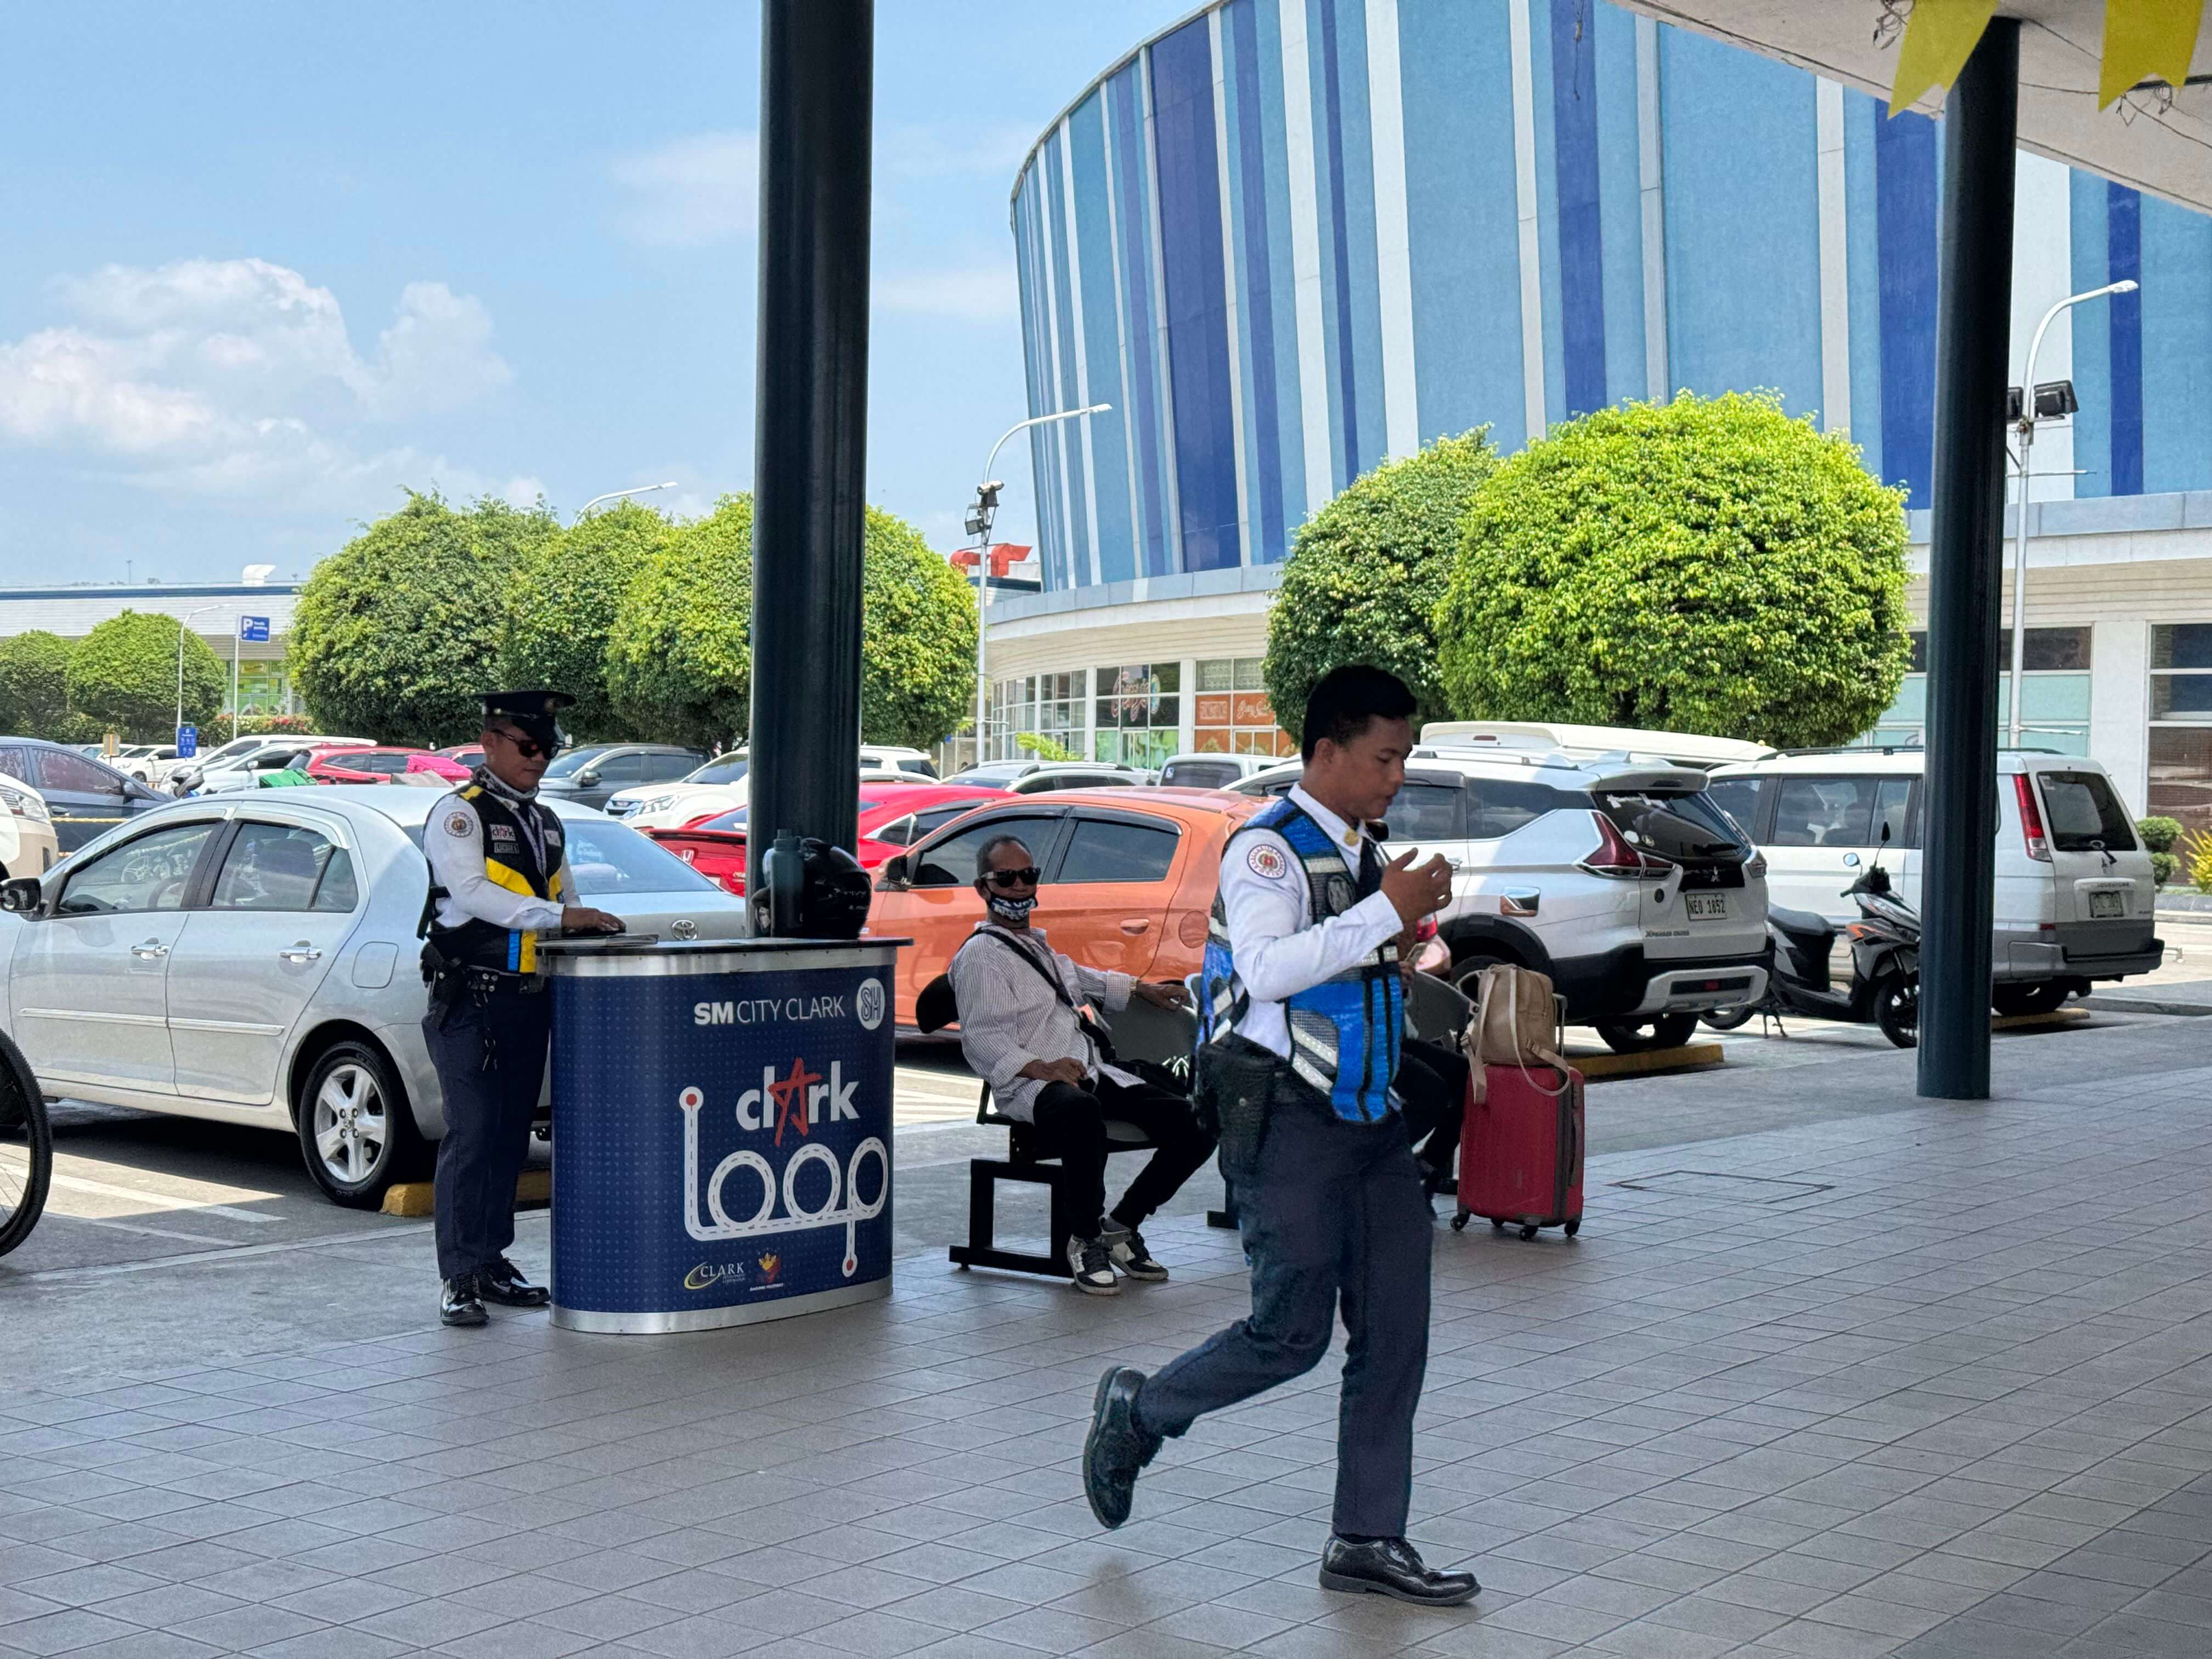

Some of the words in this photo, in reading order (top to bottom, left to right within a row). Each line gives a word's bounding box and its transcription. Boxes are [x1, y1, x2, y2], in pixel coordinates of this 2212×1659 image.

[243, 618, 253, 631] P
[694, 1001, 733, 1025] SM
[737, 998, 782, 1023] CITY
[786, 995, 846, 1021] CLARK
[679, 1086, 889, 1277] loop
[700, 1262, 744, 1278] CLARK
